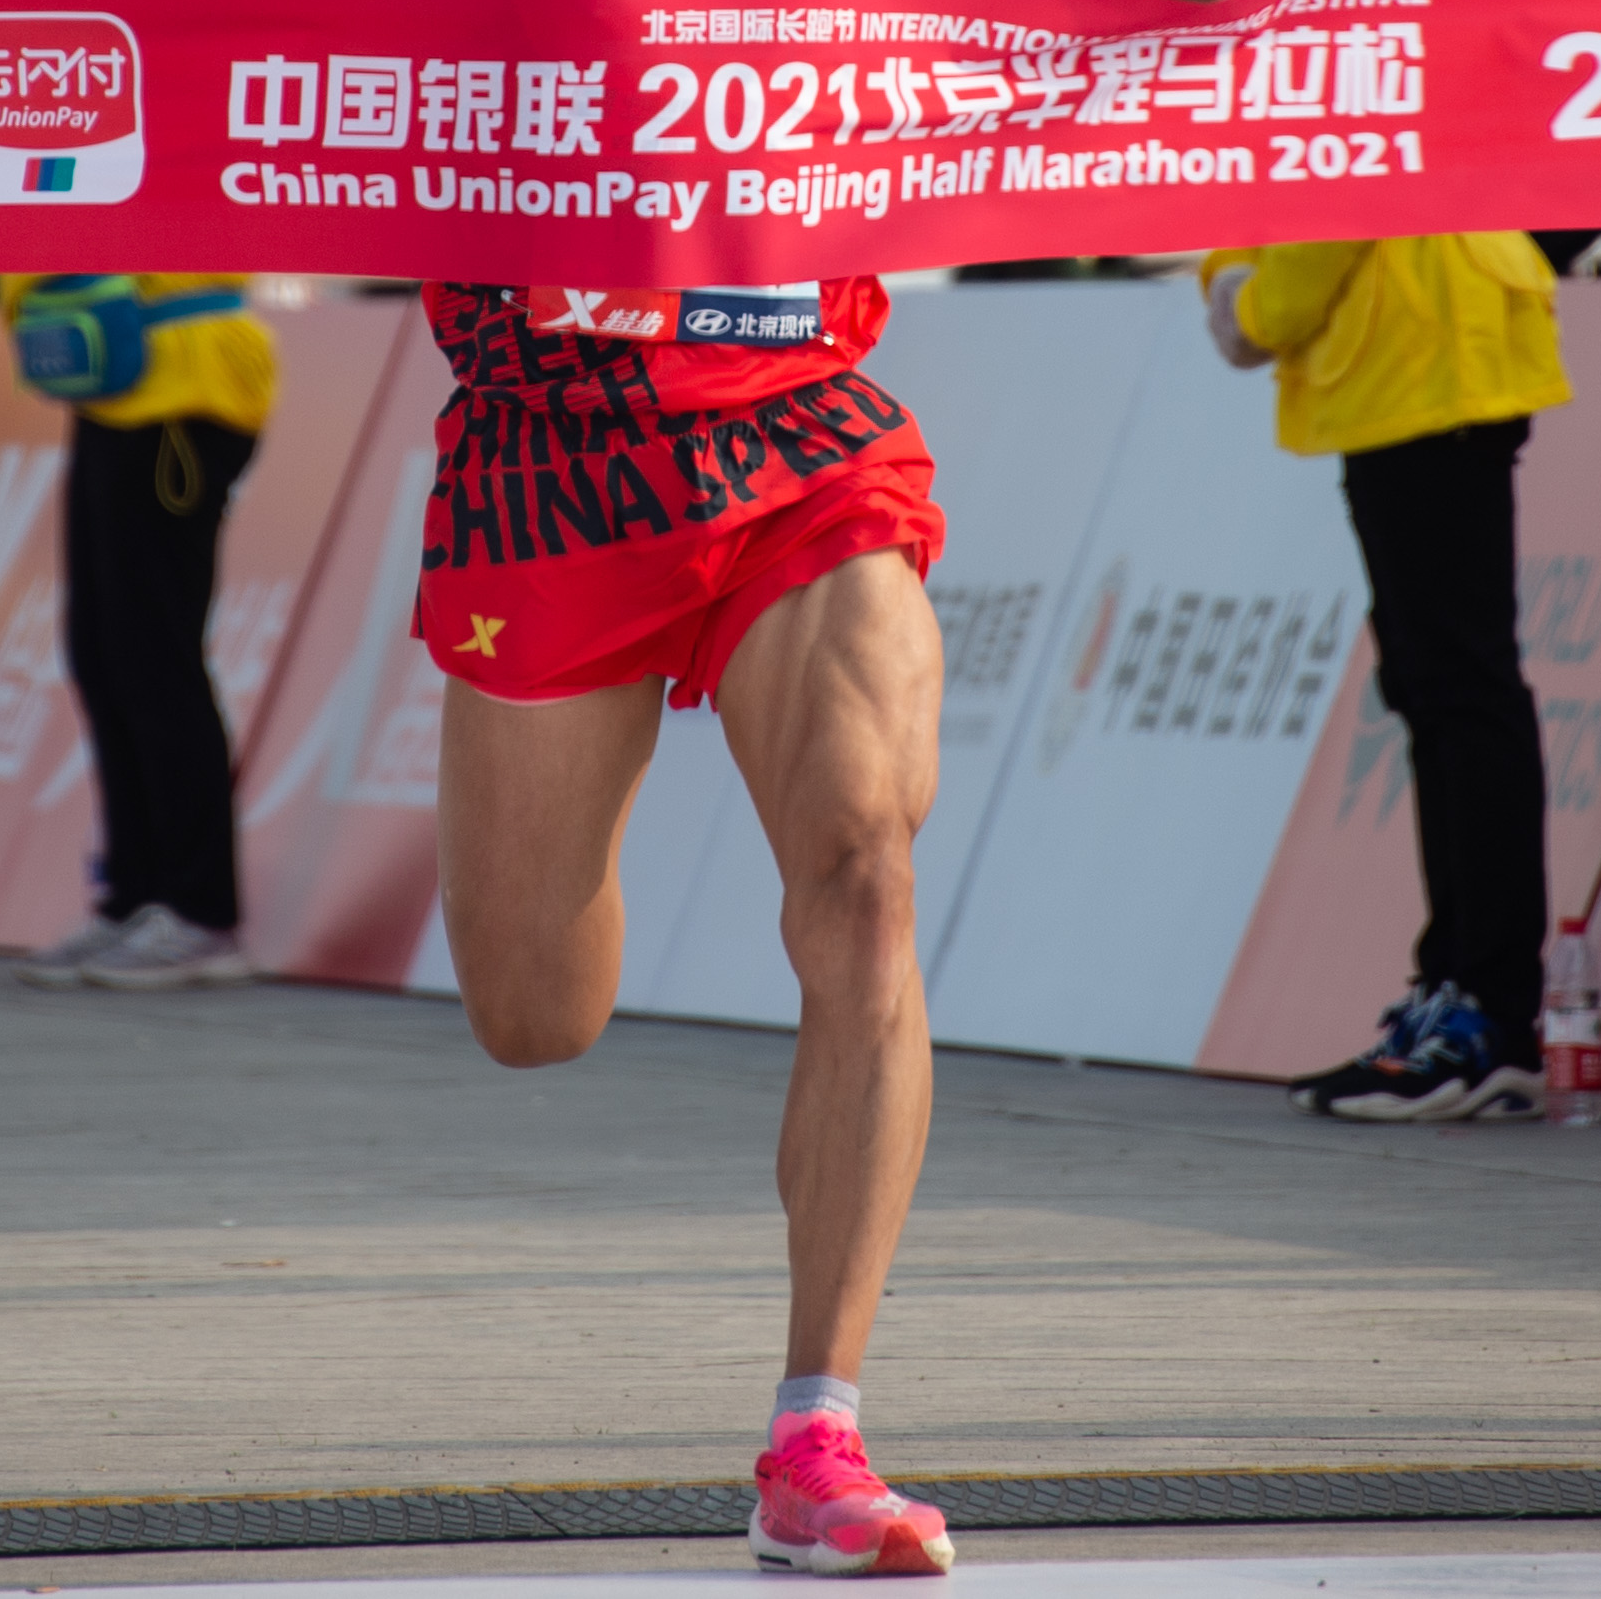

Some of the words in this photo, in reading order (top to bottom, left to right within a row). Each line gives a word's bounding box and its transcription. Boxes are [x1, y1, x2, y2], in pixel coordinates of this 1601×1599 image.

[640, 7, 856, 45] 北京国际长跑节
[227, 53, 608, 158] 中国银联
[221, 161, 398, 209] China
[412, 165, 711, 232] UnionPay
[725, 163, 892, 228] Beijing
[902, 147, 996, 203] Half
[1001, 139, 1257, 194] Marathon
[1268, 130, 1426, 184] 2021
[602, 308, 666, 338] 特步
[733, 312, 818, 340] 北京现代
[672, 369, 908, 523] SPEED
